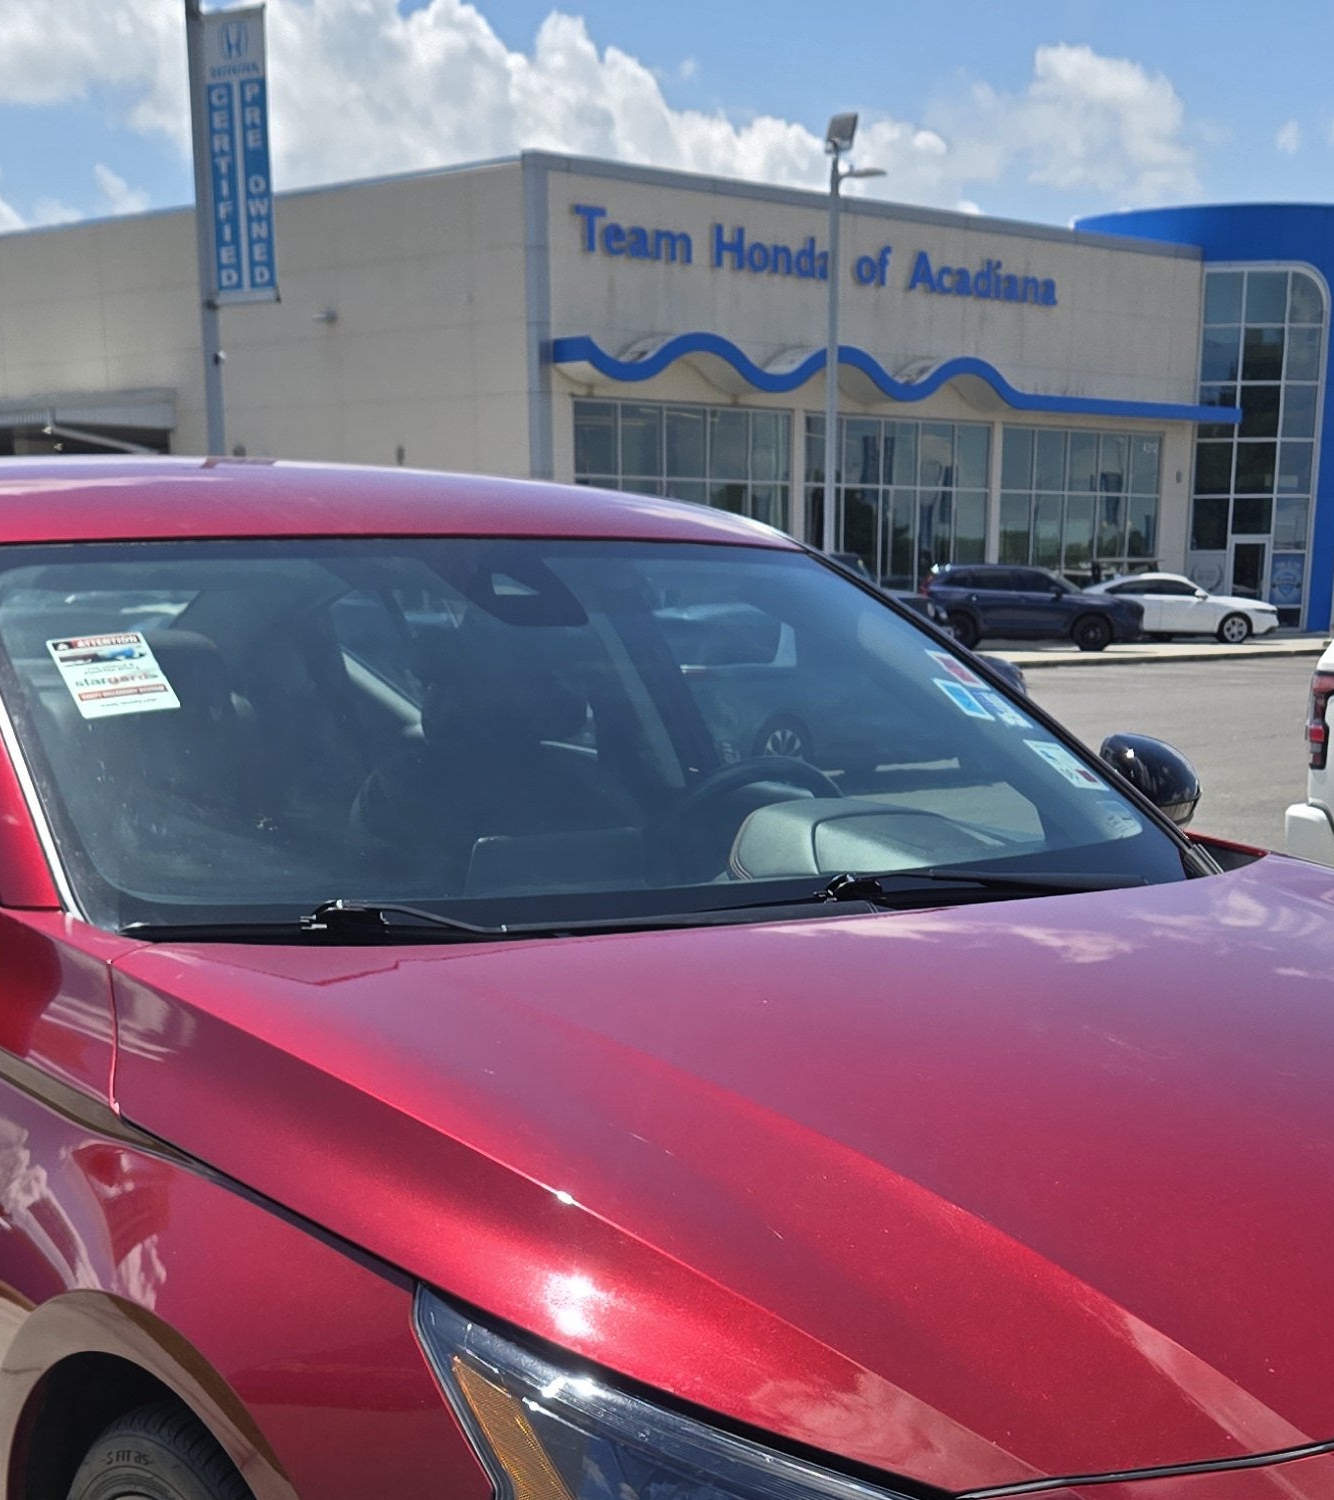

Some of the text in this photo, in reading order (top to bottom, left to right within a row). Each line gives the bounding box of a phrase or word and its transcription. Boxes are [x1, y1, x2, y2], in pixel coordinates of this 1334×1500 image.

[210, 86, 240, 287] CERTIFIED
[244, 83, 270, 284] PRE OWNED
[573, 204, 693, 265] Team
[855, 246, 893, 286] of
[908, 250, 1058, 307] Acadiana
[77, 634, 140, 648] ATTENTION
